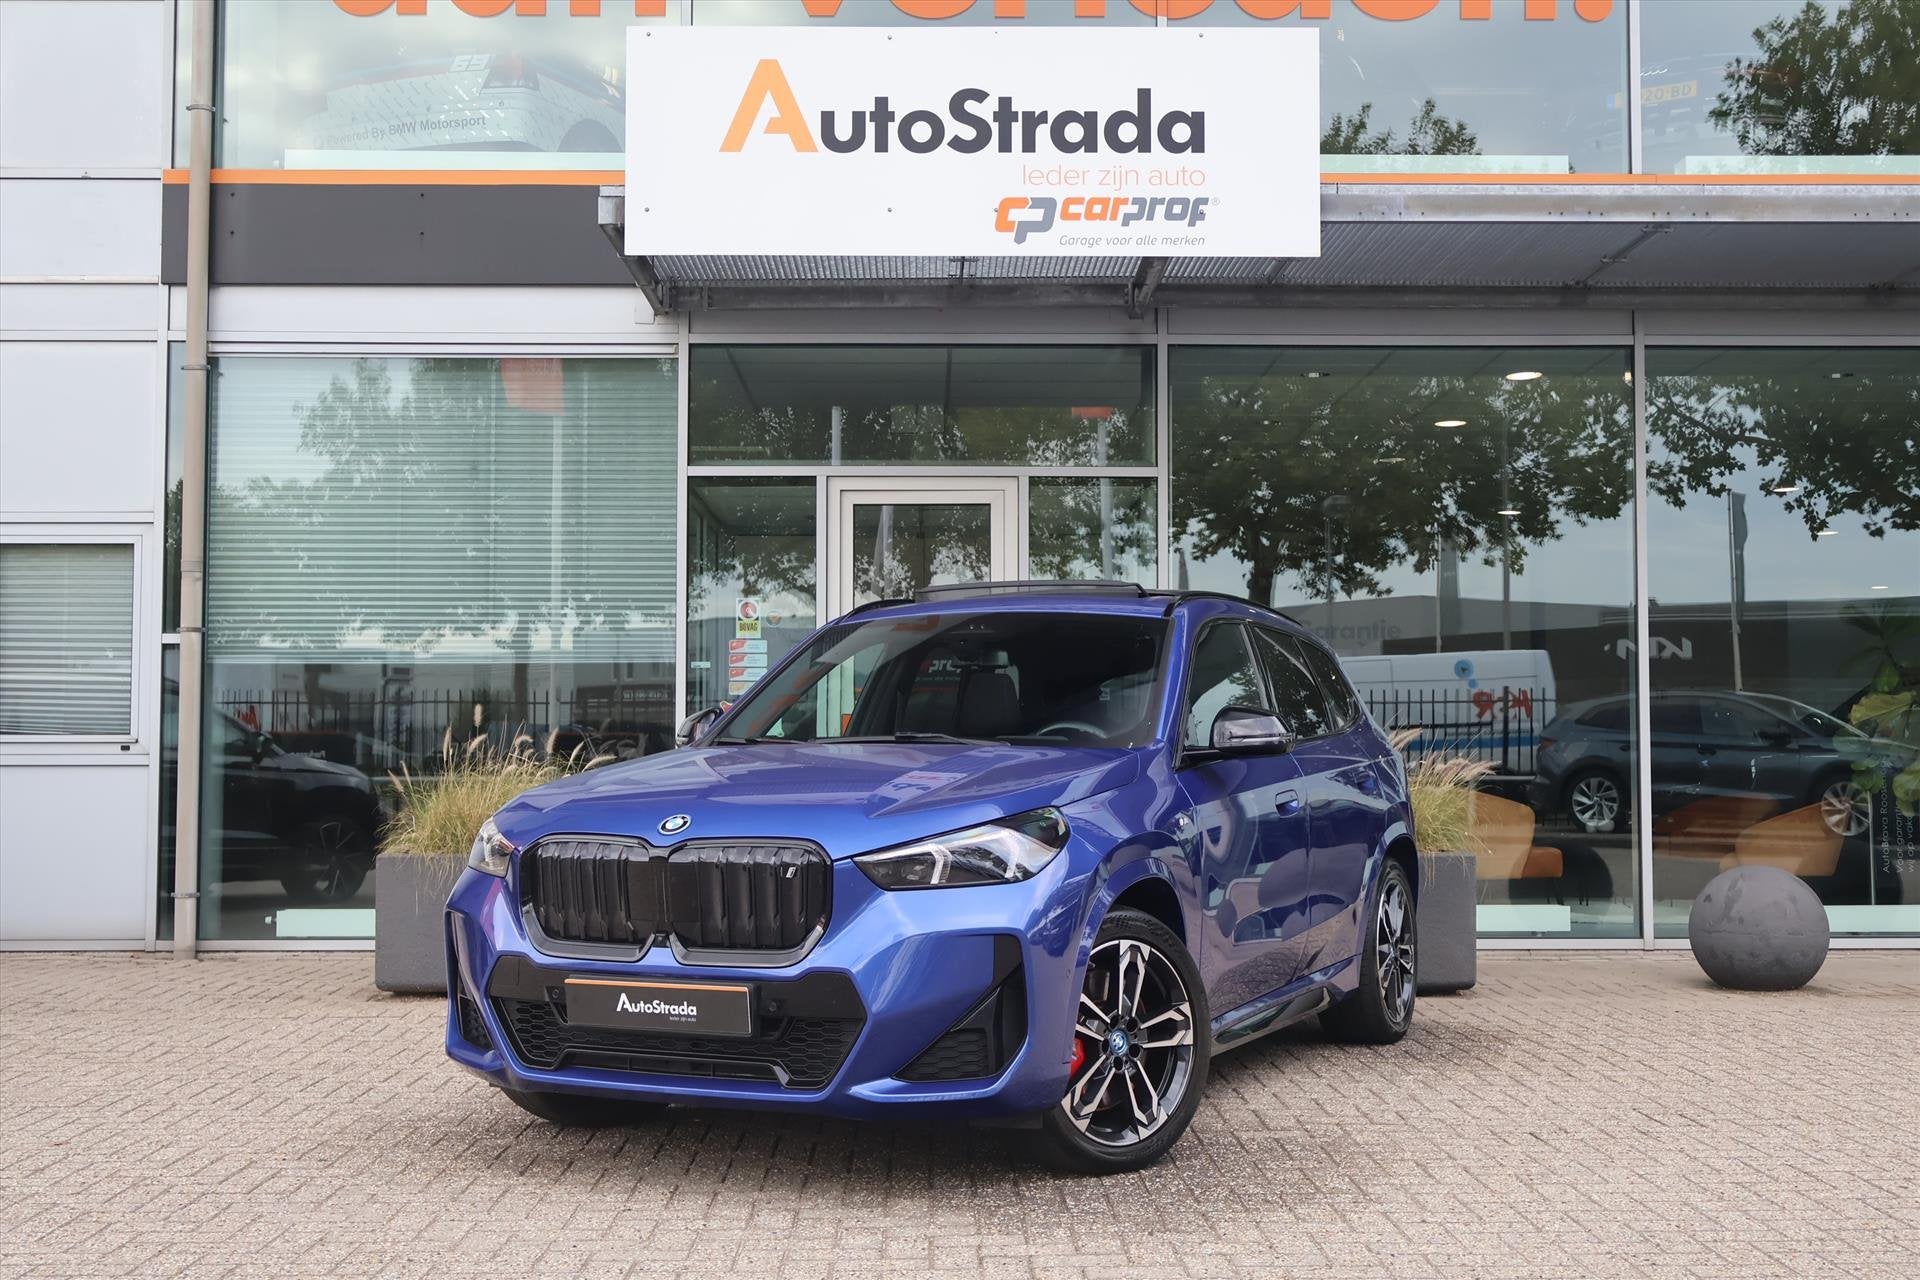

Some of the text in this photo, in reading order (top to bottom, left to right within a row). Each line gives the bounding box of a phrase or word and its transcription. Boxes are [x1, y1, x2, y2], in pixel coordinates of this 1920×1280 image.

[718, 58, 1206, 154] AutoStrada
[371, 127, 386, 140] By
[388, 122, 417, 136] BMW
[420, 115, 487, 131] Motorsport
[1022, 164, 1206, 191] Ieder zijn auto
[1059, 235, 1205, 248] Garage voor alle merken
[739, 622, 758, 632] BOVAG
[1880, 816, 1890, 873] AutoBrava
[1907, 842, 1916, 859] op
[616, 992, 697, 1016] AutoStrada
